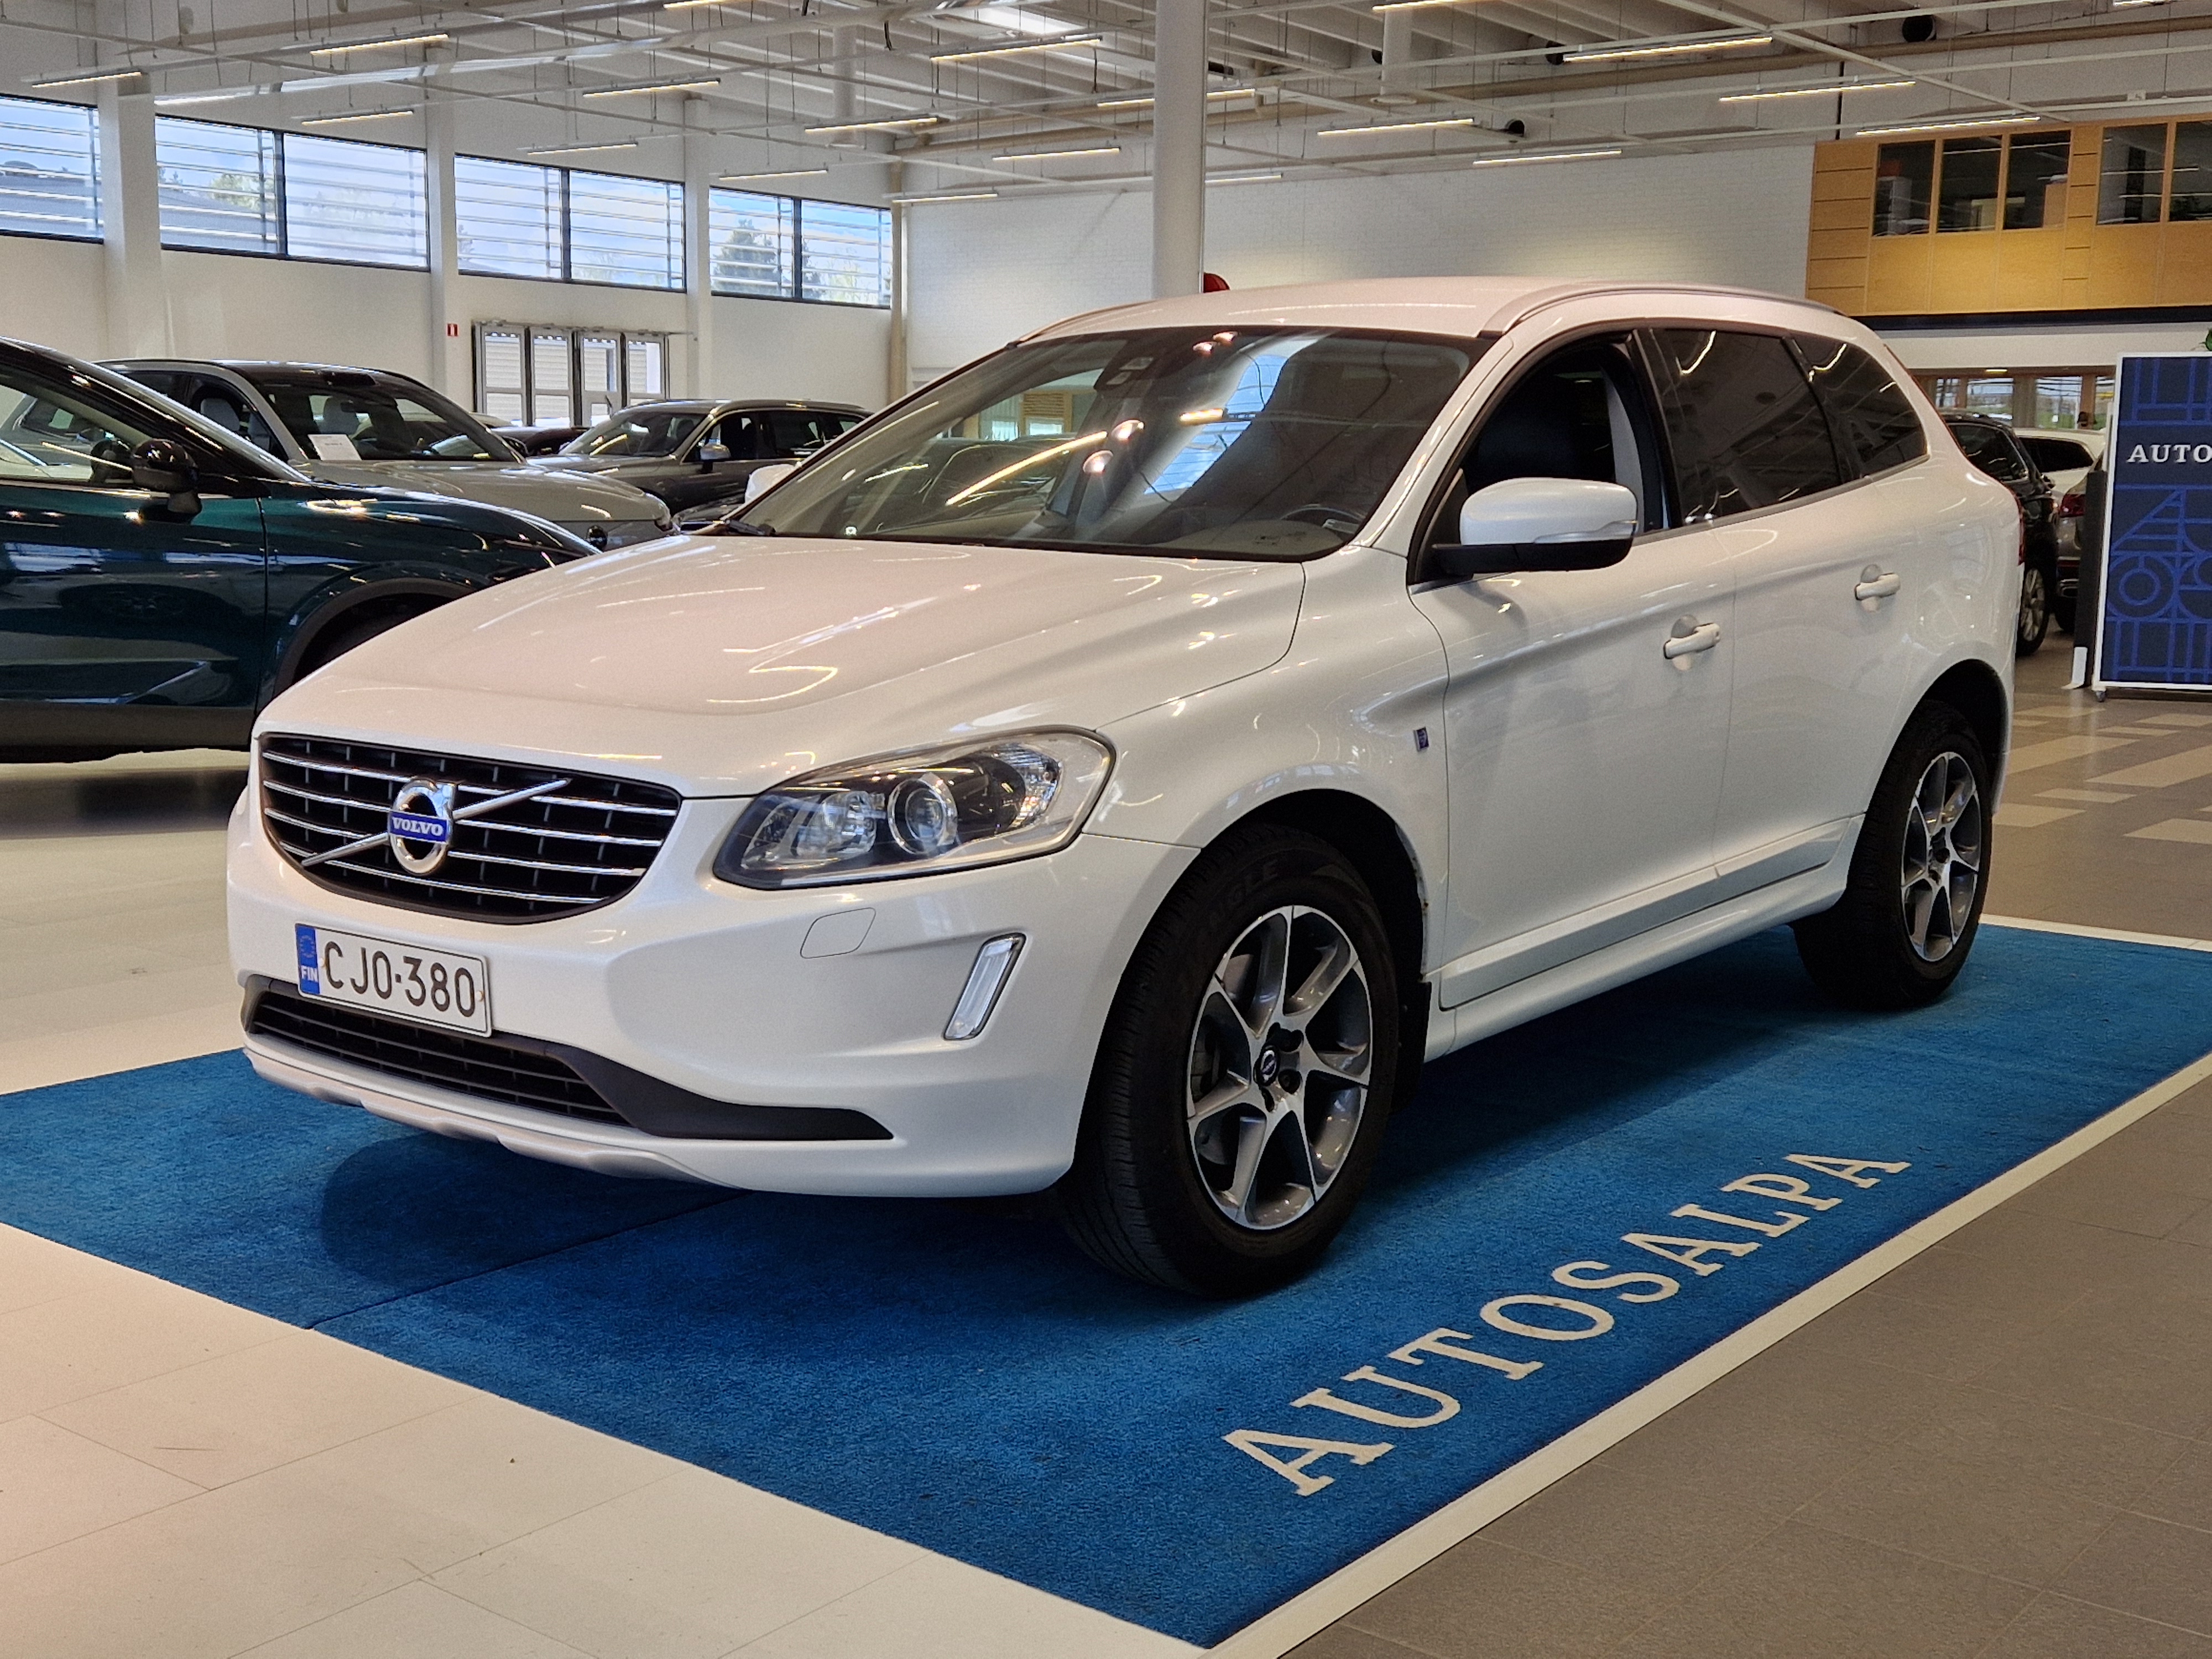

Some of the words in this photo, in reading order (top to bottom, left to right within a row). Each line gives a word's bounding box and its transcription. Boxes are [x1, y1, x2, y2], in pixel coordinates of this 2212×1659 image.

[2126, 444, 2212, 463] AUTO
[392, 816, 444, 836] VOLVO
[301, 965, 319, 982] FIN
[324, 941, 475, 1017] CJO-380
[1223, 1153, 1912, 1496] AUTOSALPA
